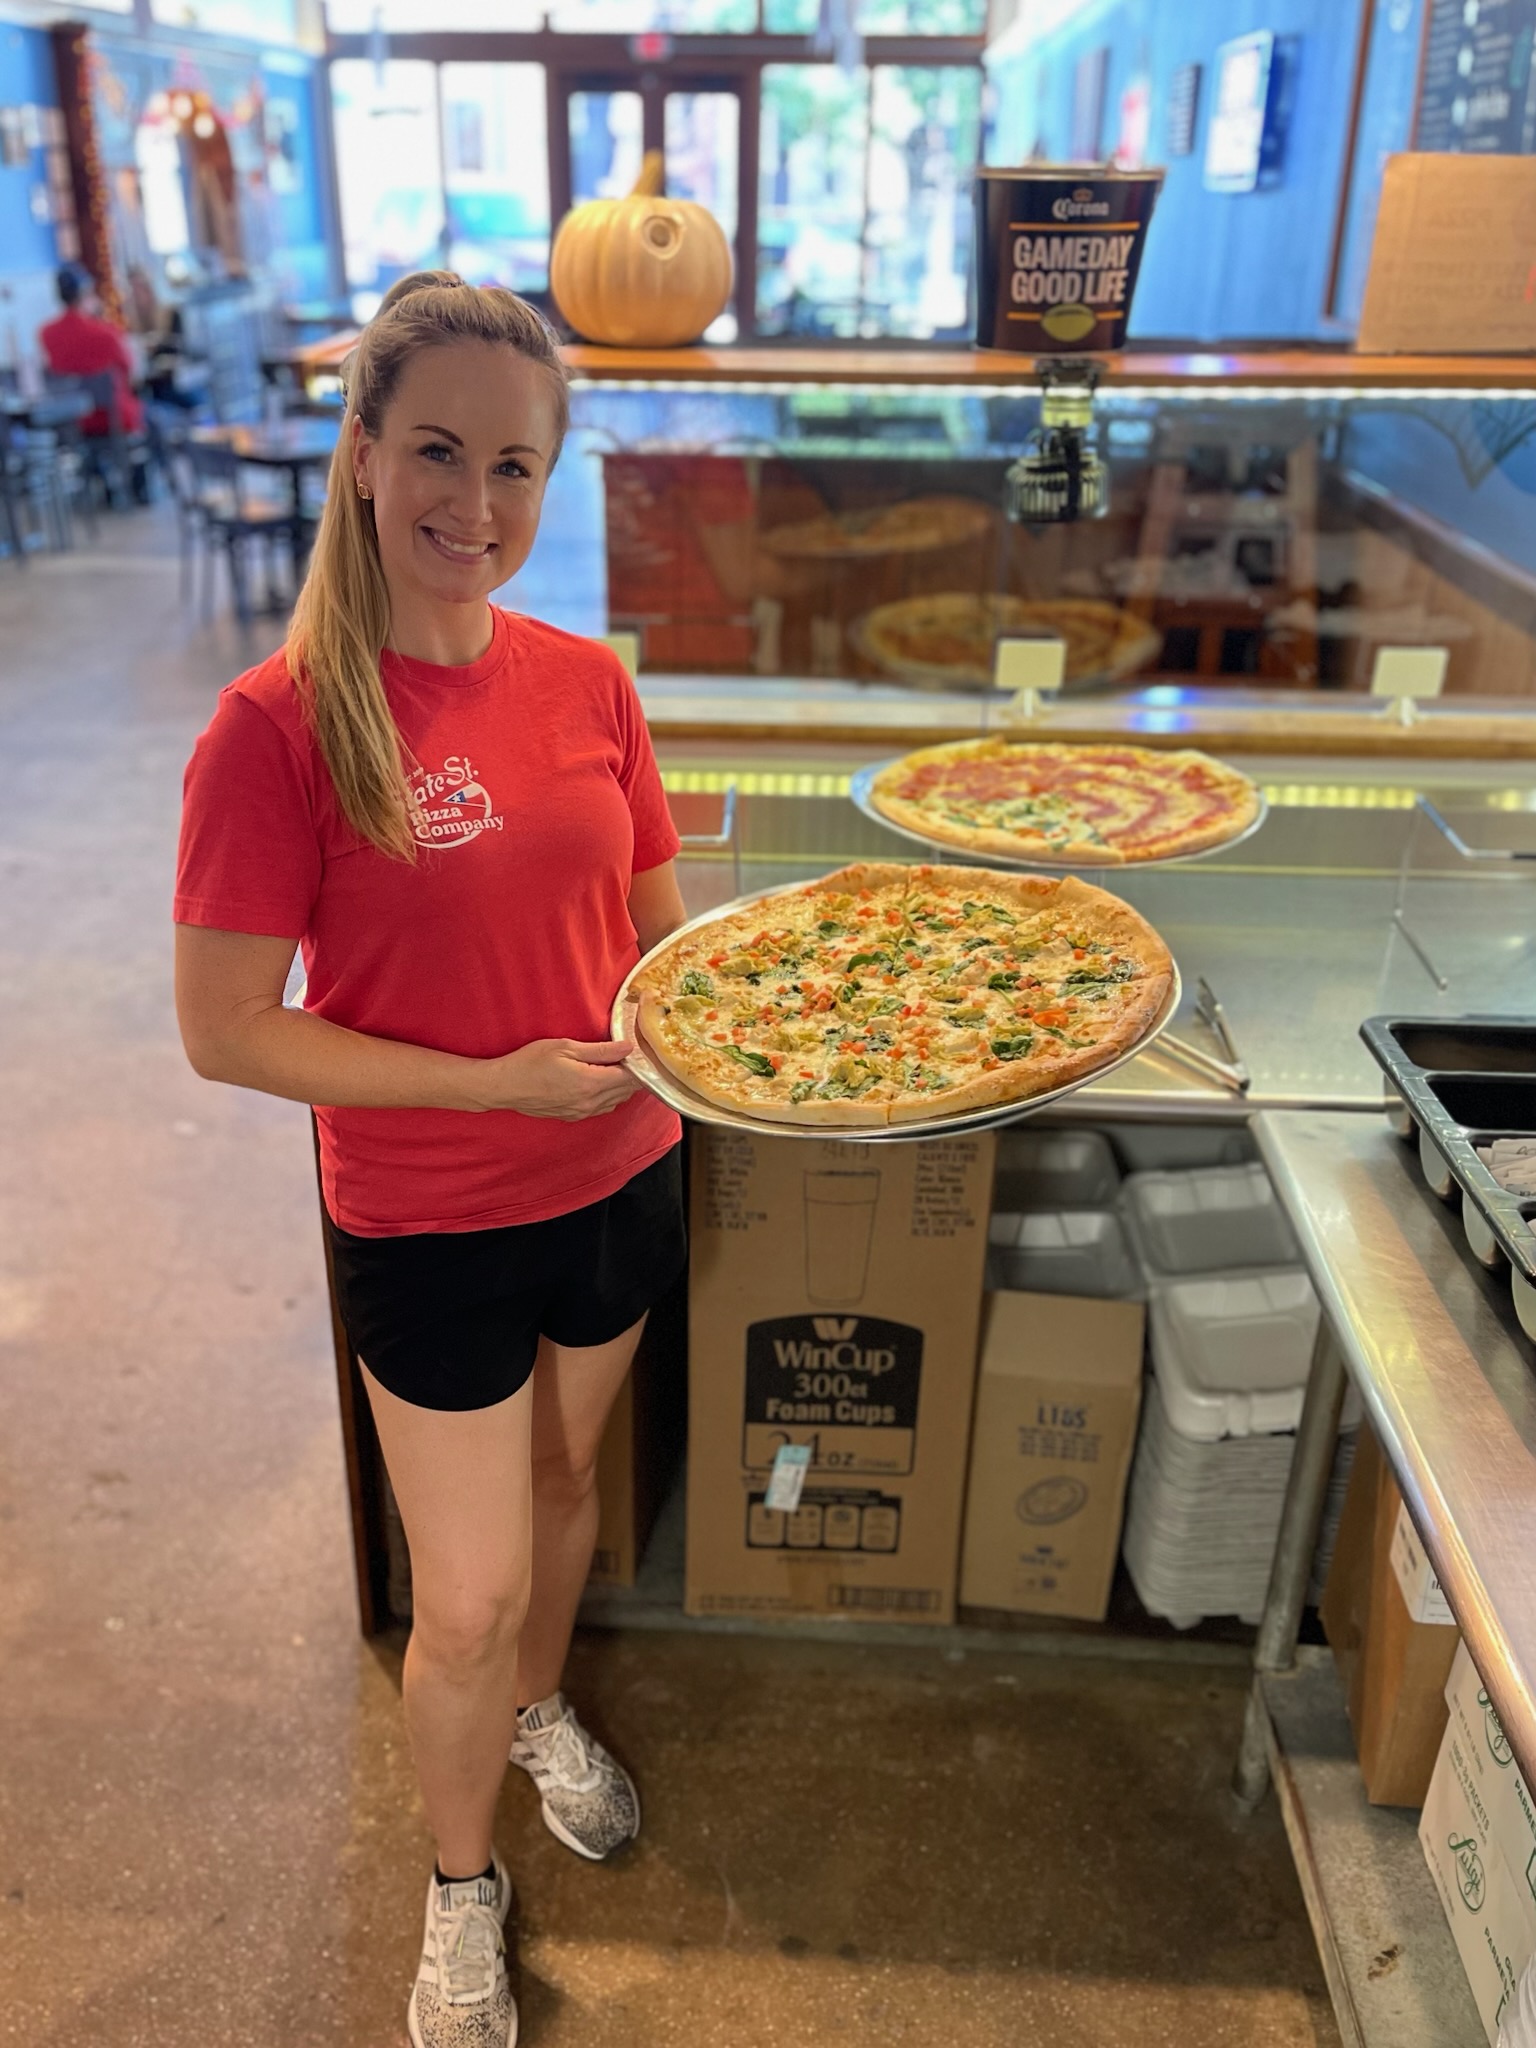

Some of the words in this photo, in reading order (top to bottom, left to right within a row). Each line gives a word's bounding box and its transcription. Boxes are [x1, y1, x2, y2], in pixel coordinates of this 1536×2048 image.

[1052, 198, 1110, 221] Corona
[1013, 235, 1135, 270] GAMEDAY
[1011, 270, 1082, 304] GOOD
[1083, 269, 1129, 304] LIFE
[443, 756, 479, 786] St.
[410, 806, 463, 826] Pizza
[415, 816, 504, 838] Company
[773, 1339, 896, 1376] WinCup
[793, 1373, 868, 1399] 300ct
[766, 1397, 831, 1421] Foam
[835, 1400, 896, 1426] Cups
[827, 1451, 855, 1467] oz
[1468, 1781, 1490, 1832] PACKETS
[1447, 1832, 1481, 1894] Luigi
[1484, 1925, 1510, 2001] PARMESA
